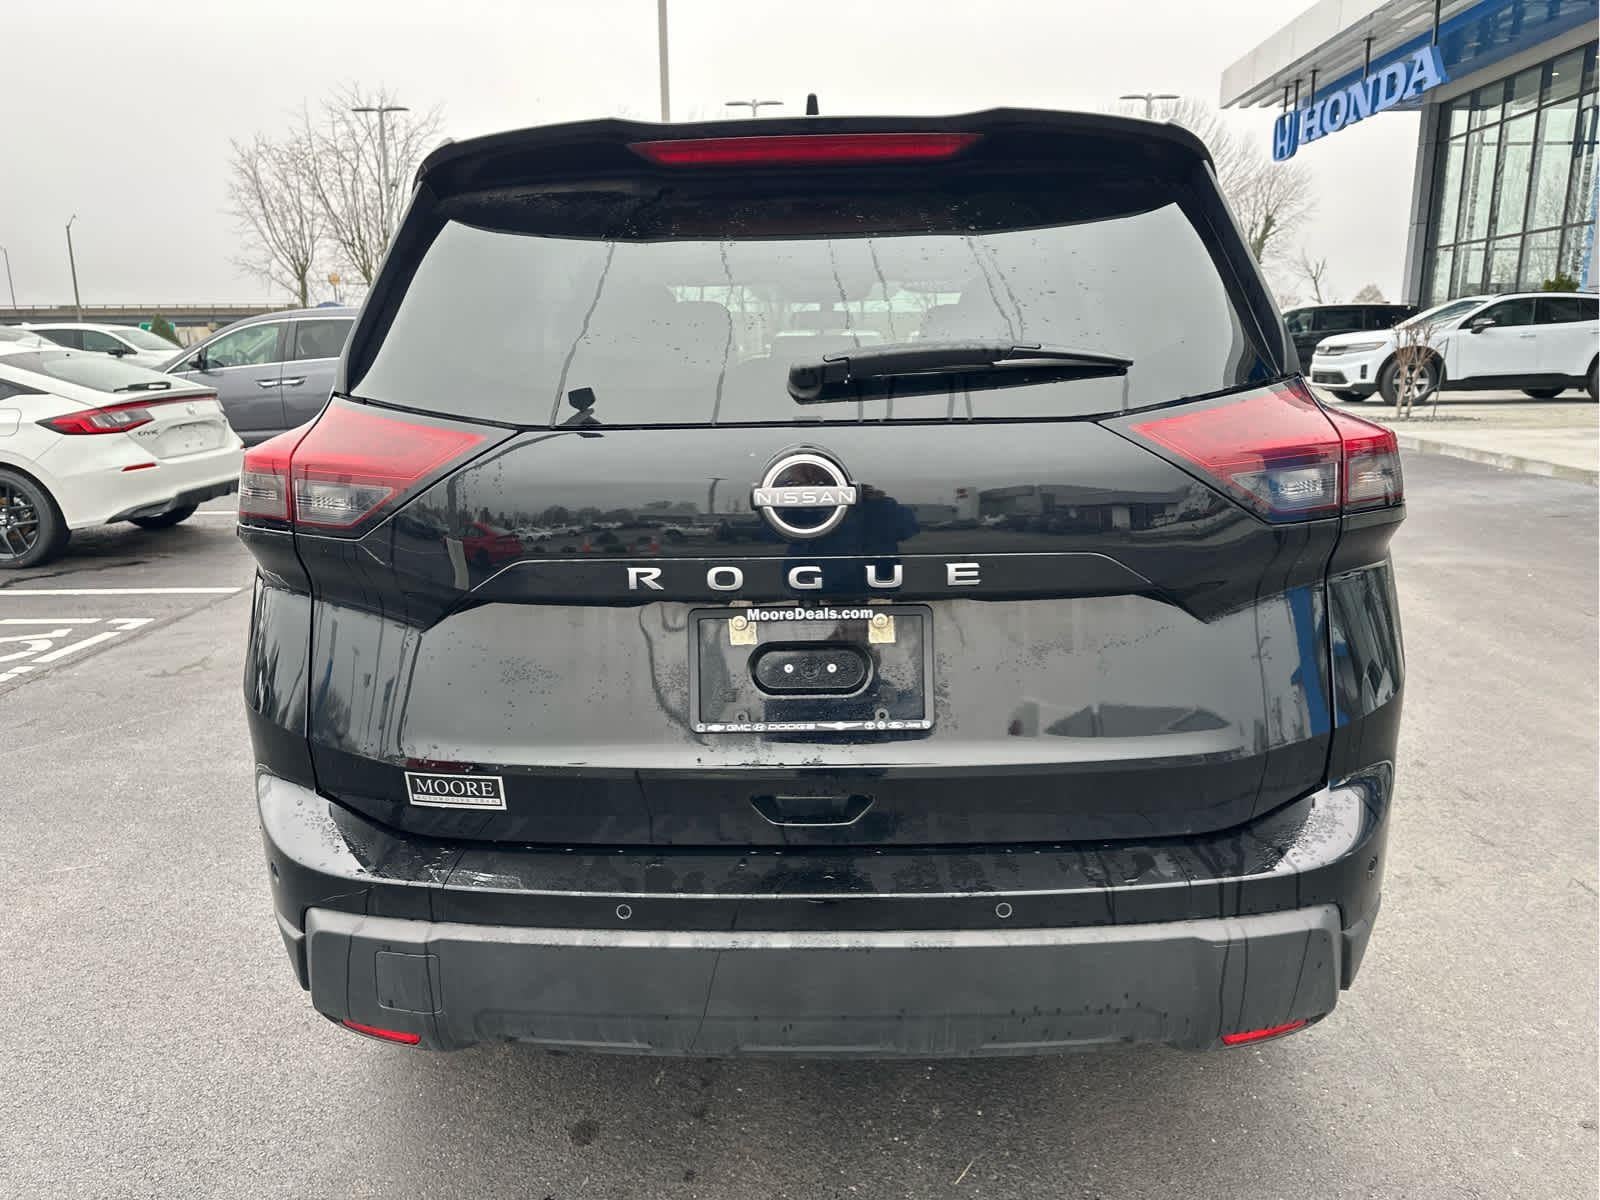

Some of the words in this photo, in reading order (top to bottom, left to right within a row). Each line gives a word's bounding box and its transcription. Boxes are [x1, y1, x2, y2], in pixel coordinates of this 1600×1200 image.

[1299, 46, 1443, 145] HONDA
[757, 491, 853, 504] NISSAN
[627, 562, 981, 591] ROGUE
[746, 607, 874, 620] MooreDeals.com
[415, 778, 495, 797] MOORE
